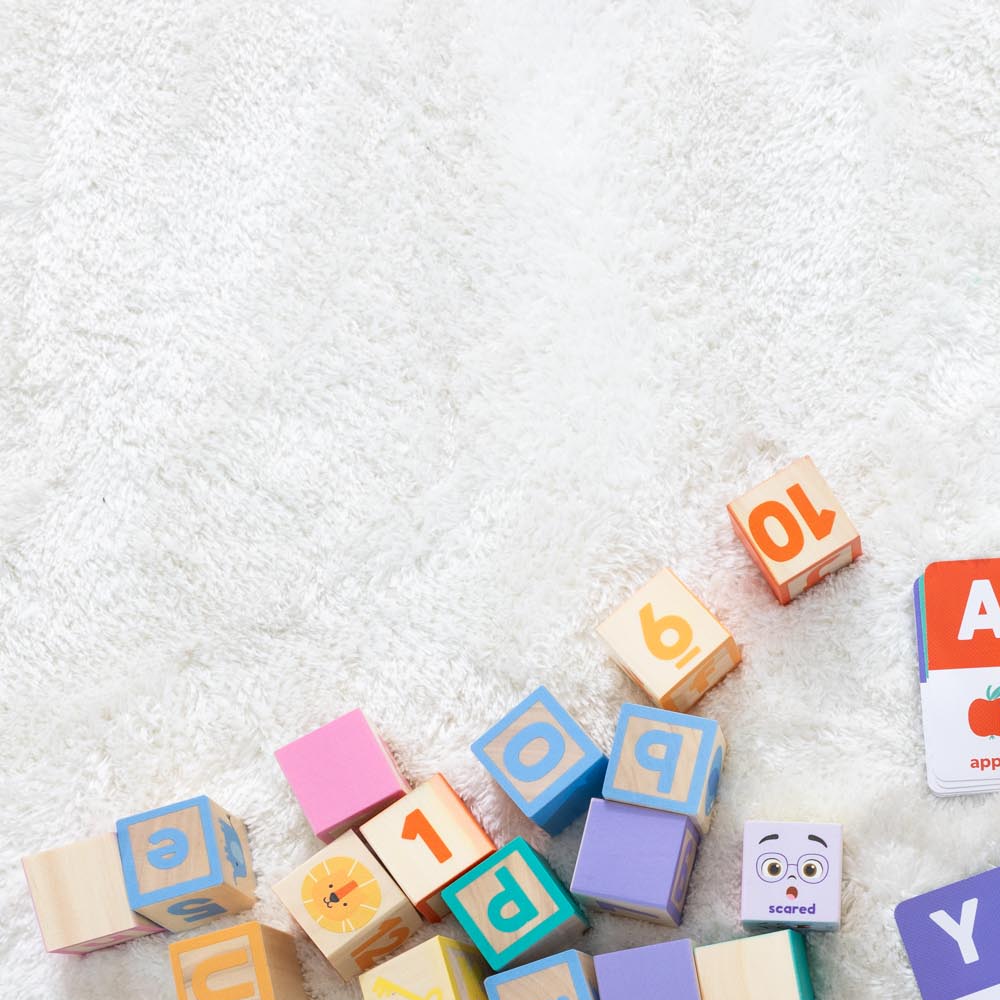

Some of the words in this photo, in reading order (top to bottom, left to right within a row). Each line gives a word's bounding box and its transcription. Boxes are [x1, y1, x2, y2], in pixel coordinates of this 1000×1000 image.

[748, 483, 836, 562] 10
[146, 828, 189, 870] e
[401, 808, 453, 863] 1
[768, 903, 816, 915] scared
[929, 897, 980, 965] Y
